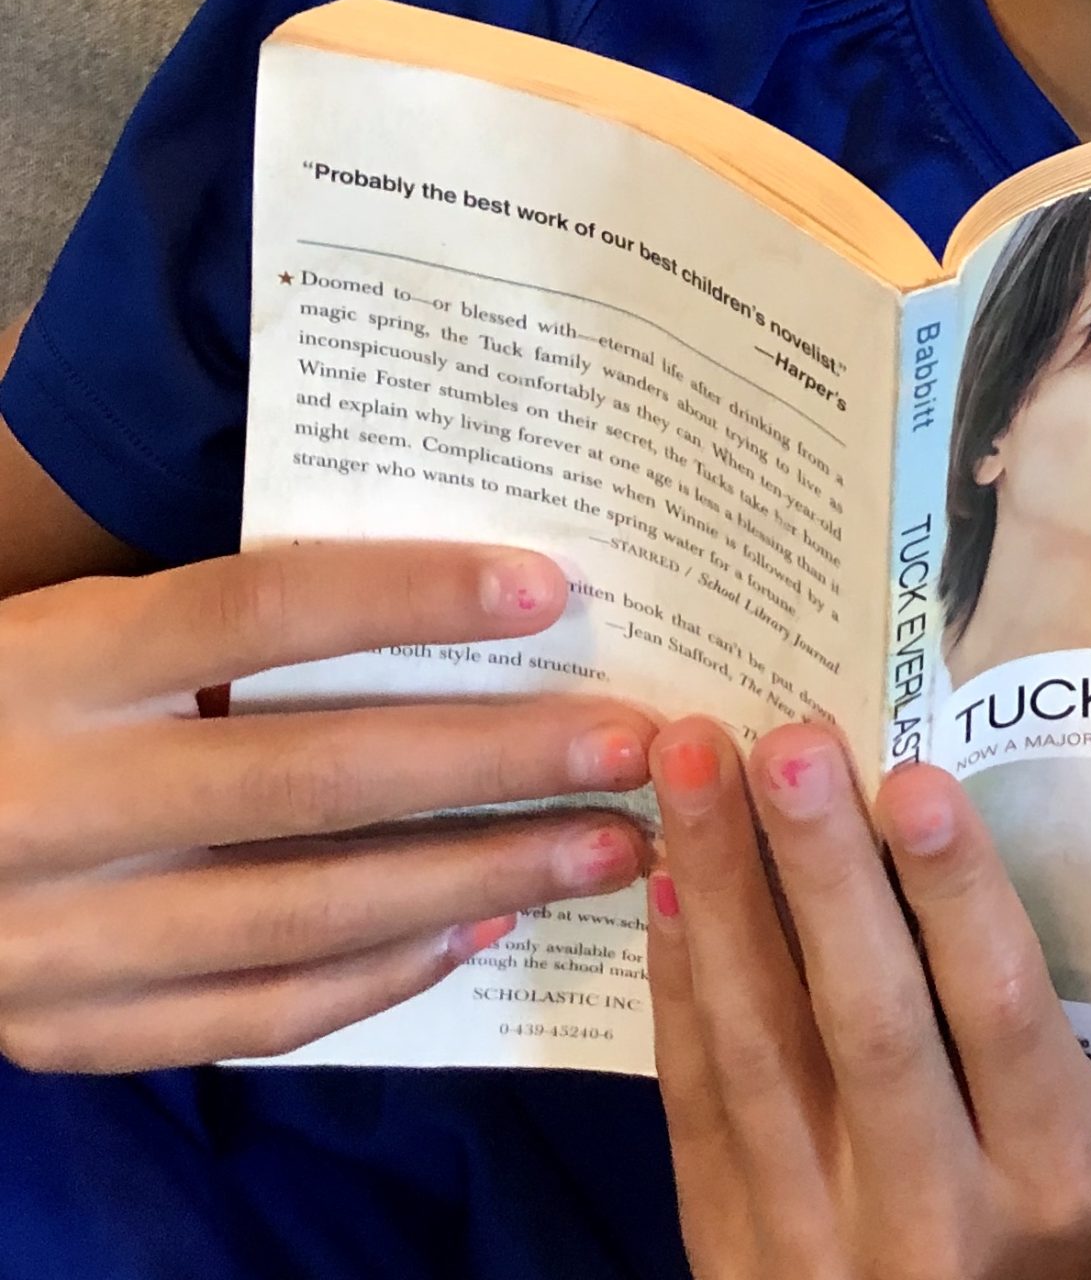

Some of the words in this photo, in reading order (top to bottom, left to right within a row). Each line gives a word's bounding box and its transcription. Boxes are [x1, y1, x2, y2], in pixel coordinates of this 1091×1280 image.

[422, 183, 457, 203] the
[464, 191, 510, 216] best
[518, 205, 568, 231] work
[574, 221, 596, 238] of
[601, 231, 633, 252] our
[639, 242, 678, 276] best
[299, 331, 448, 370] inconspicuously
[456, 359, 489, 378] and
[497, 369, 606, 408] comfortably
[613, 399, 630, 411] as
[637, 403, 669, 432] they
[712, 442, 755, 478] When
[300, 303, 357, 323] magic
[369, 312, 430, 338] spring,
[441, 327, 468, 345] the
[479, 335, 523, 358] Tuck
[535, 346, 592, 375] family
[602, 366, 669, 401] wanders
[677, 395, 717, 430] about
[725, 426, 768, 464] trying
[775, 454, 789, 474] to
[798, 470, 822, 497] live
[830, 496, 843, 515] as
[301, 271, 384, 297] Doomed
[461, 302, 527, 330] blessed
[662, 357, 684, 381] life
[690, 377, 722, 406] after
[729, 400, 790, 451] drinking
[797, 441, 830, 479] from
[836, 473, 844, 486] a
[913, 321, 941, 431] Babbitt
[293, 450, 370, 475] stranger
[376, 461, 415, 478] who
[423, 469, 474, 489] wants
[482, 476, 499, 491] to
[505, 484, 567, 509] market
[574, 496, 600, 517] the
[606, 507, 658, 541] spring
[664, 528, 704, 558] water
[710, 546, 730, 572] for
[735, 568, 743, 580] a
[296, 392, 331, 409] and
[339, 397, 408, 422] explain
[416, 404, 454, 430] why
[461, 413, 511, 442] living
[519, 428, 581, 454] forever
[588, 447, 602, 461] at
[609, 456, 640, 472] one
[646, 468, 672, 488] age
[679, 478, 689, 493] is
[695, 486, 720, 511] less
[725, 509, 732, 520] a
[737, 512, 793, 564] blessing
[797, 555, 826, 585] than
[831, 579, 839, 595] it
[299, 359, 366, 383] Winnie
[376, 369, 431, 393] Foster
[439, 382, 518, 412] stumbles
[527, 403, 549, 418] on
[558, 408, 598, 431] their
[606, 421, 657, 456] secret,
[665, 446, 688, 467] the
[694, 457, 734, 494] Tucks
[740, 488, 769, 516] take
[775, 509, 797, 533] her
[803, 529, 841, 568] home
[295, 421, 349, 442] might
[359, 431, 412, 448] seem.
[423, 436, 553, 476] Complications
[563, 469, 602, 489] arise
[612, 482, 656, 508] when
[665, 500, 719, 538] Winnie
[726, 534, 736, 549] is
[743, 544, 801, 594] followed
[808, 588, 825, 613] by
[831, 610, 839, 622] a
[899, 513, 932, 613] TUCK
[390, 644, 431, 658] both
[439, 647, 481, 665] style
[488, 652, 521, 667] and
[529, 656, 610, 682] structure.
[565, 580, 615, 602] ritten
[623, 592, 663, 620] book
[671, 613, 701, 637] that
[708, 629, 743, 658] can't
[749, 650, 765, 673] be
[771, 671, 793, 694] put
[698, 572, 740, 604] School
[744, 598, 791, 643] Library
[792, 632, 840, 675] Journal
[668, 636, 732, 681] Stafford,
[740, 672, 762, 697] The
[766, 690, 796, 718] New
[892, 613, 926, 772] EVERLAST
[955, 744, 998, 772] NOW
[1004, 740, 1017, 753] A
[505, 939, 538, 956] only
[546, 942, 615, 959] available
[622, 949, 642, 962] for
[524, 956, 547, 969] the
[553, 960, 604, 975] school
[557, 911, 572, 921] at
[472, 987, 600, 1007] SCHOLASTIC
